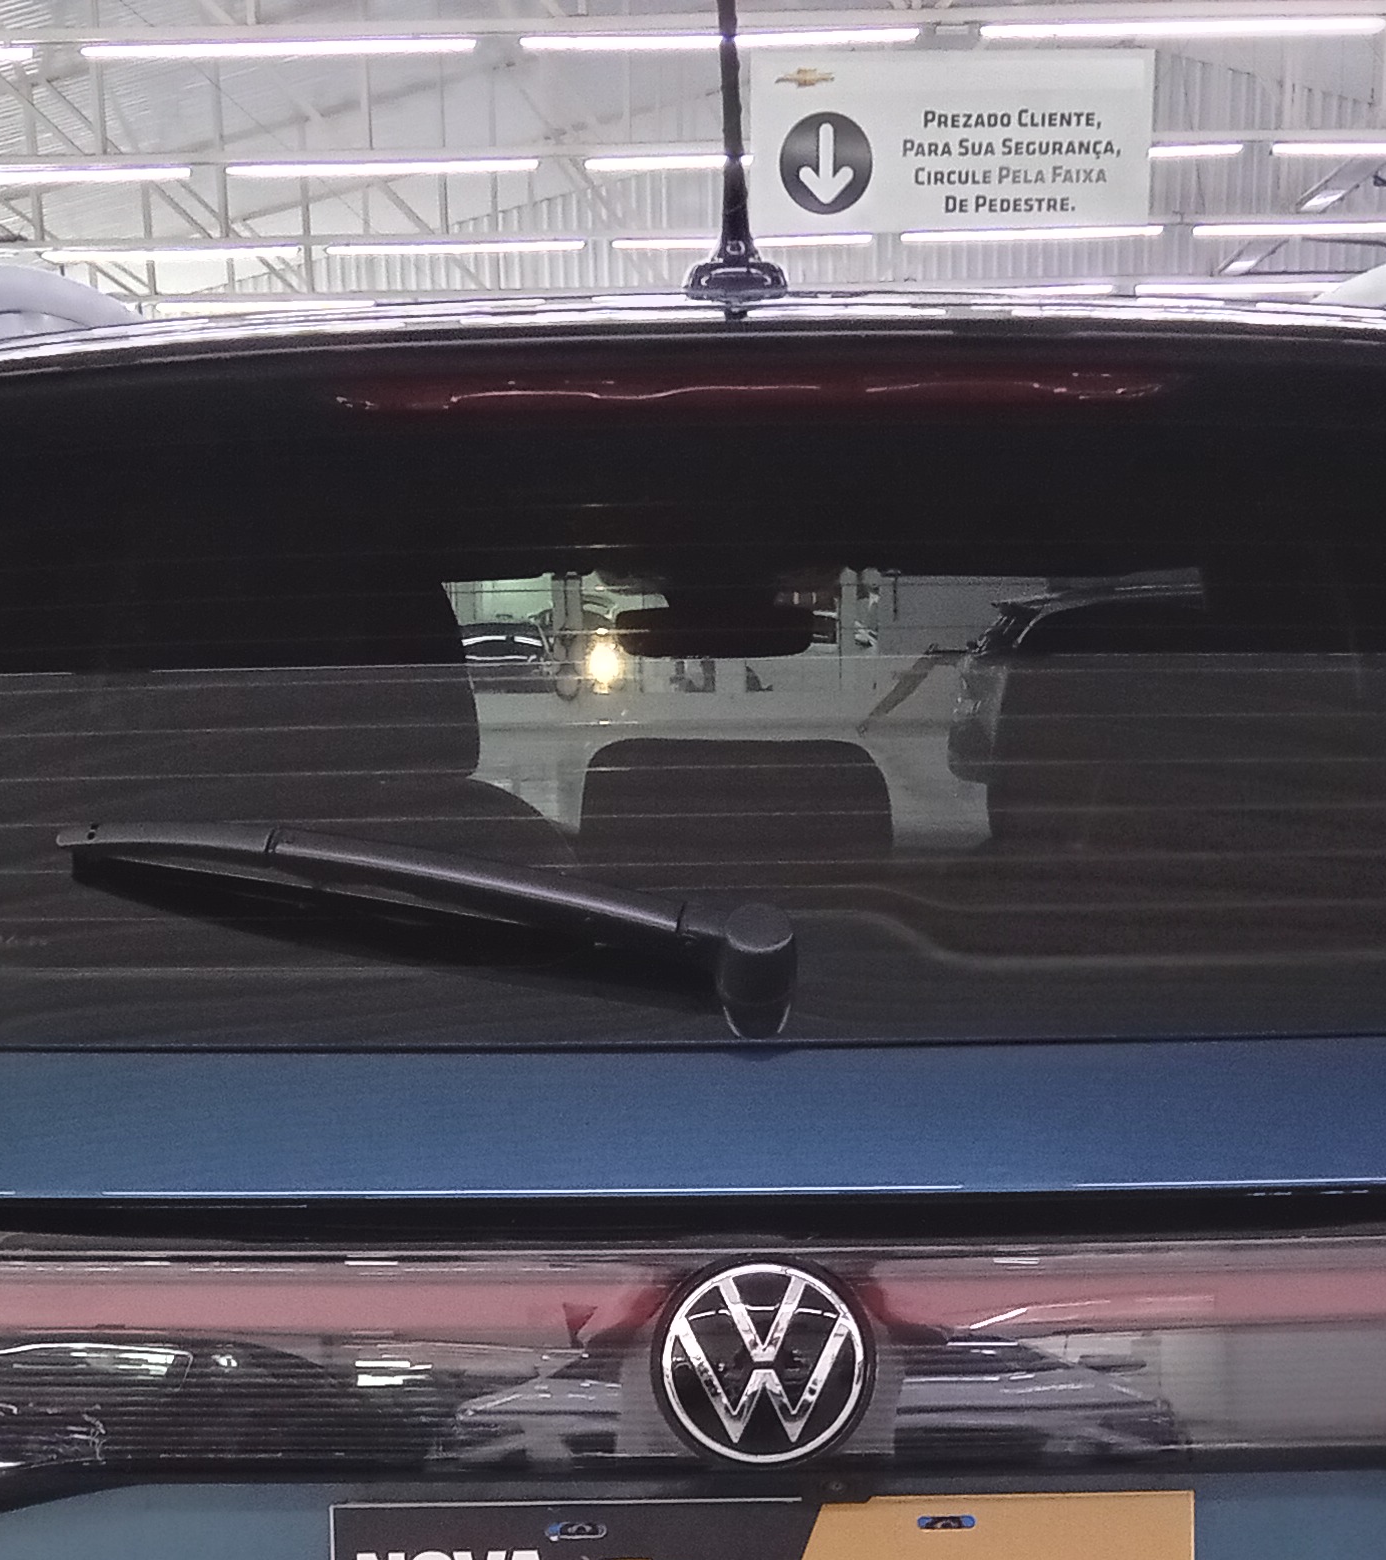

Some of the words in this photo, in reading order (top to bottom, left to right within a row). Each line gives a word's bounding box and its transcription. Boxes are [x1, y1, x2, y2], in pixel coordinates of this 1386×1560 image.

[923, 110, 1012, 129] PREZADO
[1017, 109, 1102, 130] CLIENTE,
[902, 139, 952, 158] PARA
[958, 138, 996, 157] SUA
[1001, 138, 1121, 159] SEGURANÇA,
[914, 167, 992, 186] CIRCULE
[997, 166, 1045, 185] PELA
[1051, 165, 1107, 184] FAIXA
[944, 195, 968, 213] DE
[974, 194, 1076, 213] PEDESTRE.
